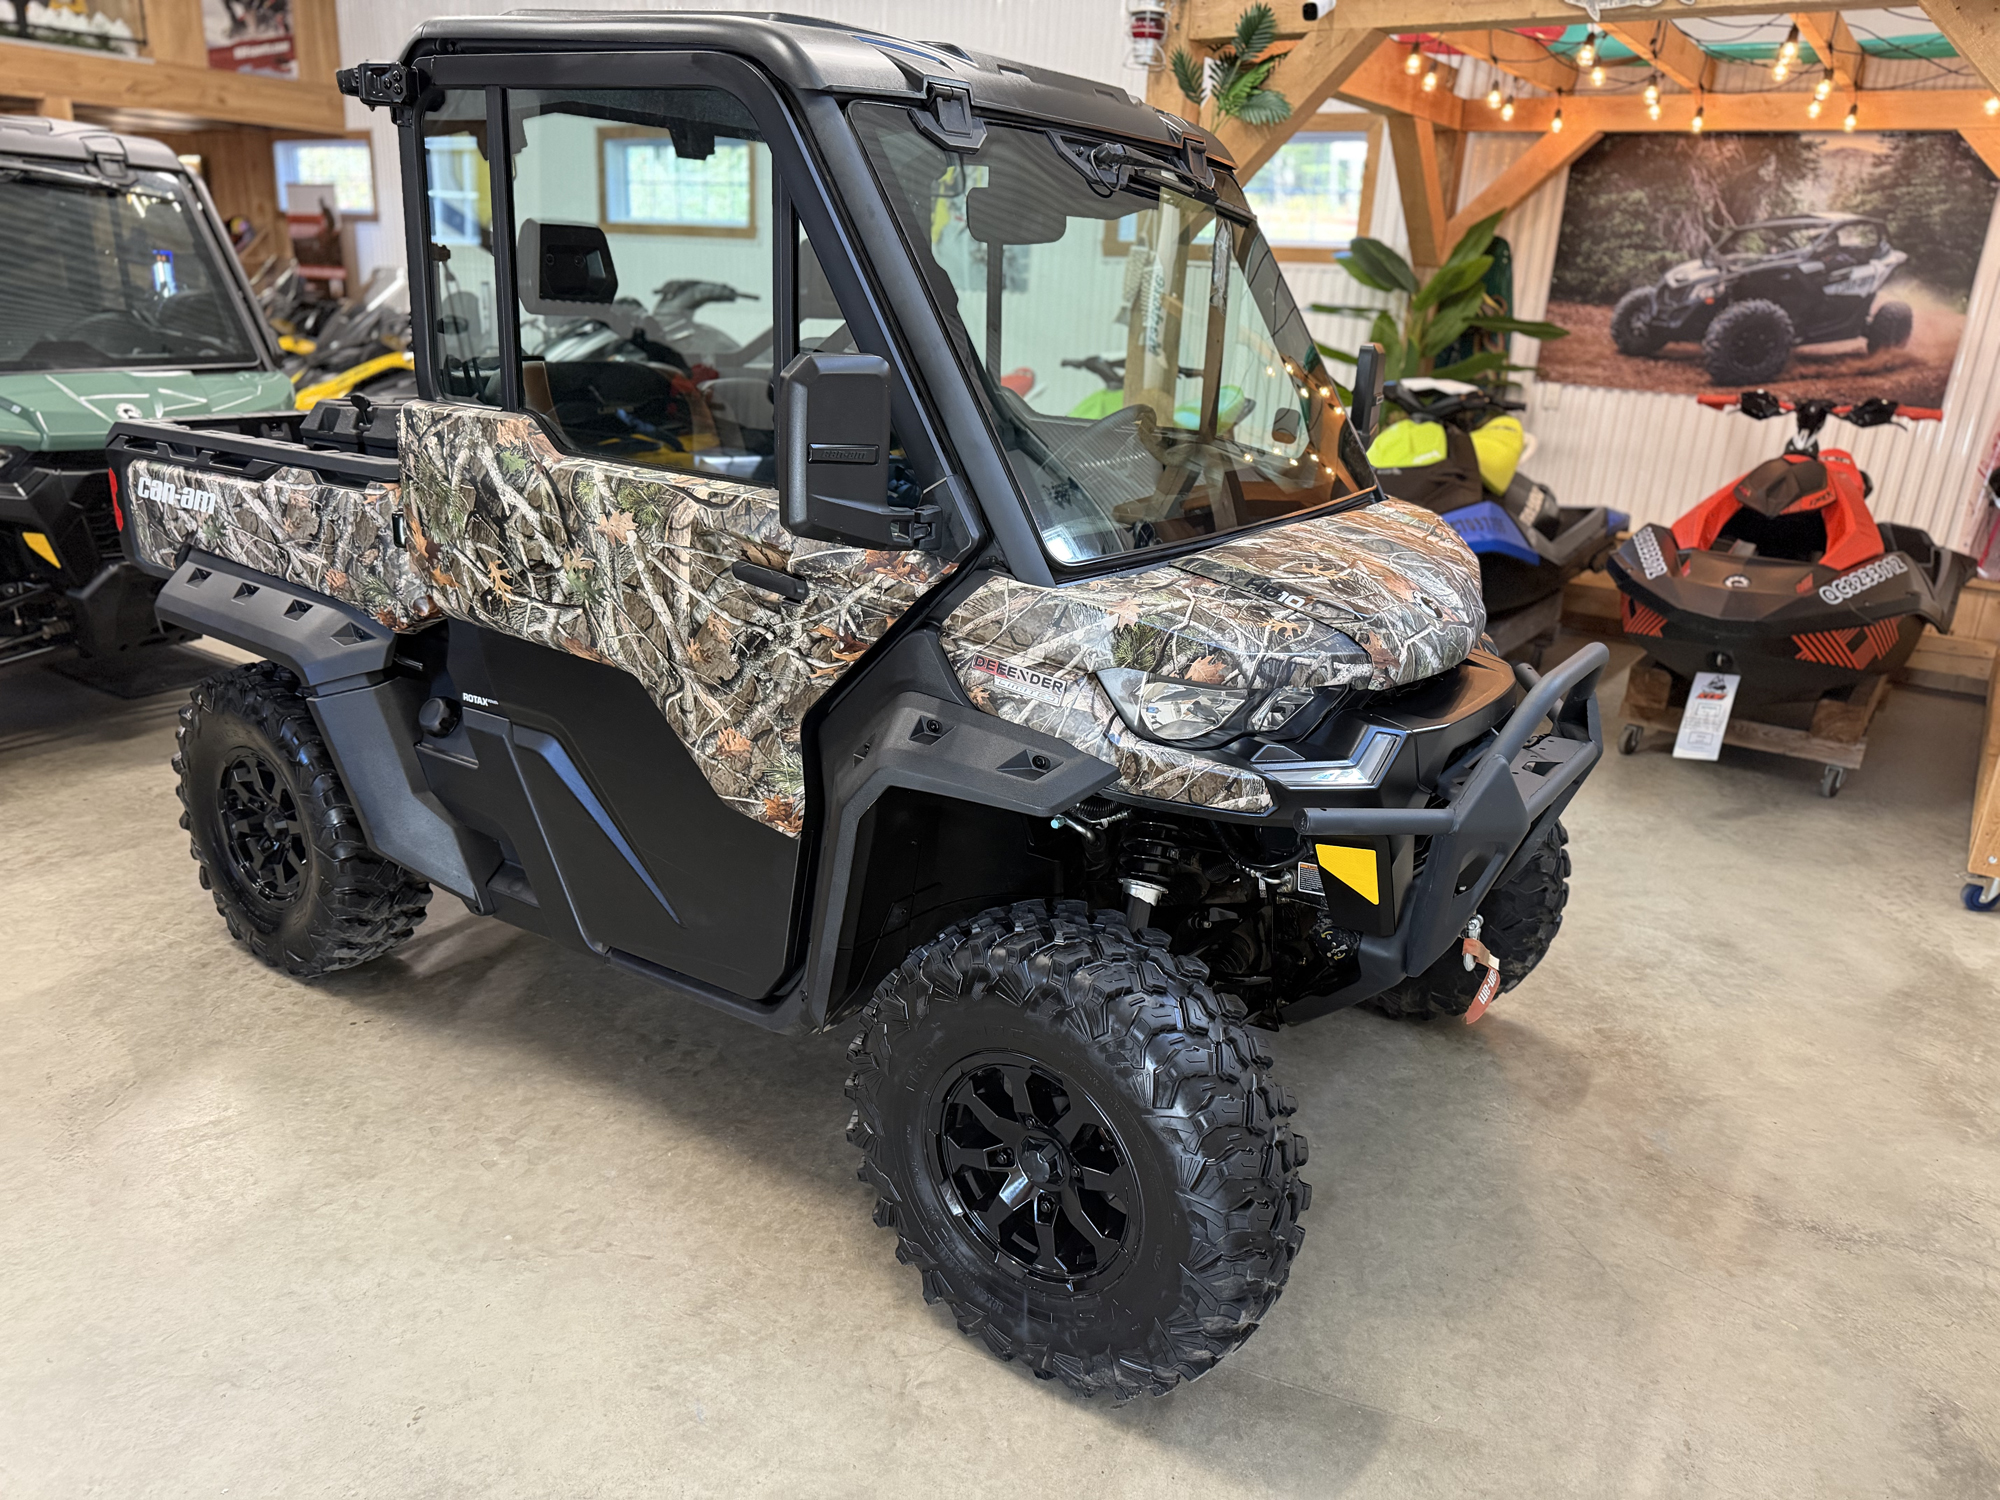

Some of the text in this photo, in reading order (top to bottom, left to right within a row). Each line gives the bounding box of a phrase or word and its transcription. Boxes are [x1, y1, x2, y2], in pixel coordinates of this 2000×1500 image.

[137, 476, 216, 515] can-am
[1244, 577, 1306, 609] HD10
[975, 656, 1064, 692] DEFENDER
[462, 692, 489, 707] ROTAX
